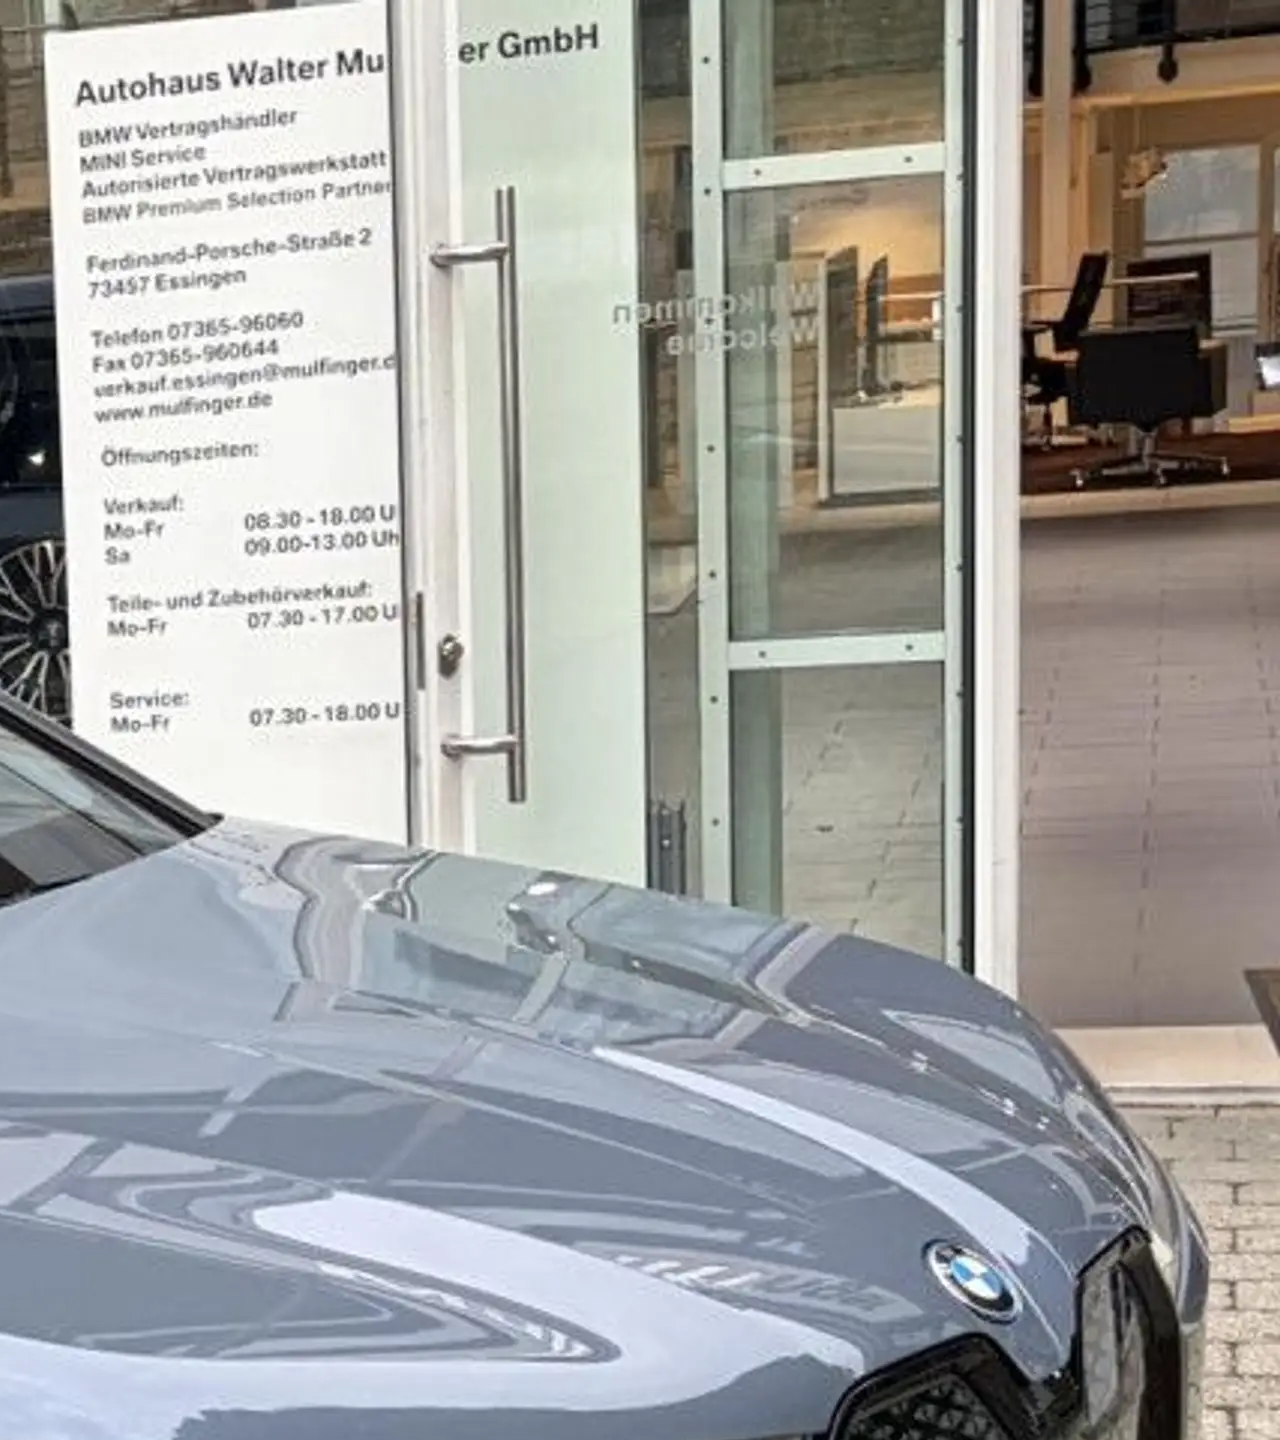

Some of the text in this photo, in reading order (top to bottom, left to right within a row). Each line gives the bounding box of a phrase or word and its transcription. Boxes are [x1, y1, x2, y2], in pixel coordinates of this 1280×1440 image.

[76, 71, 221, 107] Autohaus
[227, 56, 328, 88] Walter
[497, 23, 598, 59] GmbH
[79, 109, 297, 149] BMW Vertragshändler
[80, 145, 206, 174] MINI Service
[83, 149, 387, 198] Autorisierte Vertragswerkstatt
[83, 179, 391, 225] BMW Premium Selection Partner
[359, 228, 372, 246] 2
[88, 269, 247, 299] 73457 Essingen
[91, 328, 163, 349] Telefon
[92, 354, 126, 373] Fax
[94, 353, 396, 398] verkauf.essingen@mulfinger.d
[101, 440, 259, 467] Öffnungszeiten:
[104, 493, 184, 515] Verkauf:
[104, 520, 165, 540] Mo-Fr
[244, 509, 301, 531] 08.30
[320, 506, 375, 526] 18.00
[104, 546, 131, 565] Sa
[372, 529, 400, 549] Uh
[167, 590, 202, 610] und
[107, 617, 169, 638] Mo-Fr
[247, 609, 304, 630] 07.30
[110, 690, 190, 710] Service:
[110, 714, 170, 733] Mo-Fr
[250, 707, 306, 727] 07.30
[325, 702, 380, 722] 18.00
